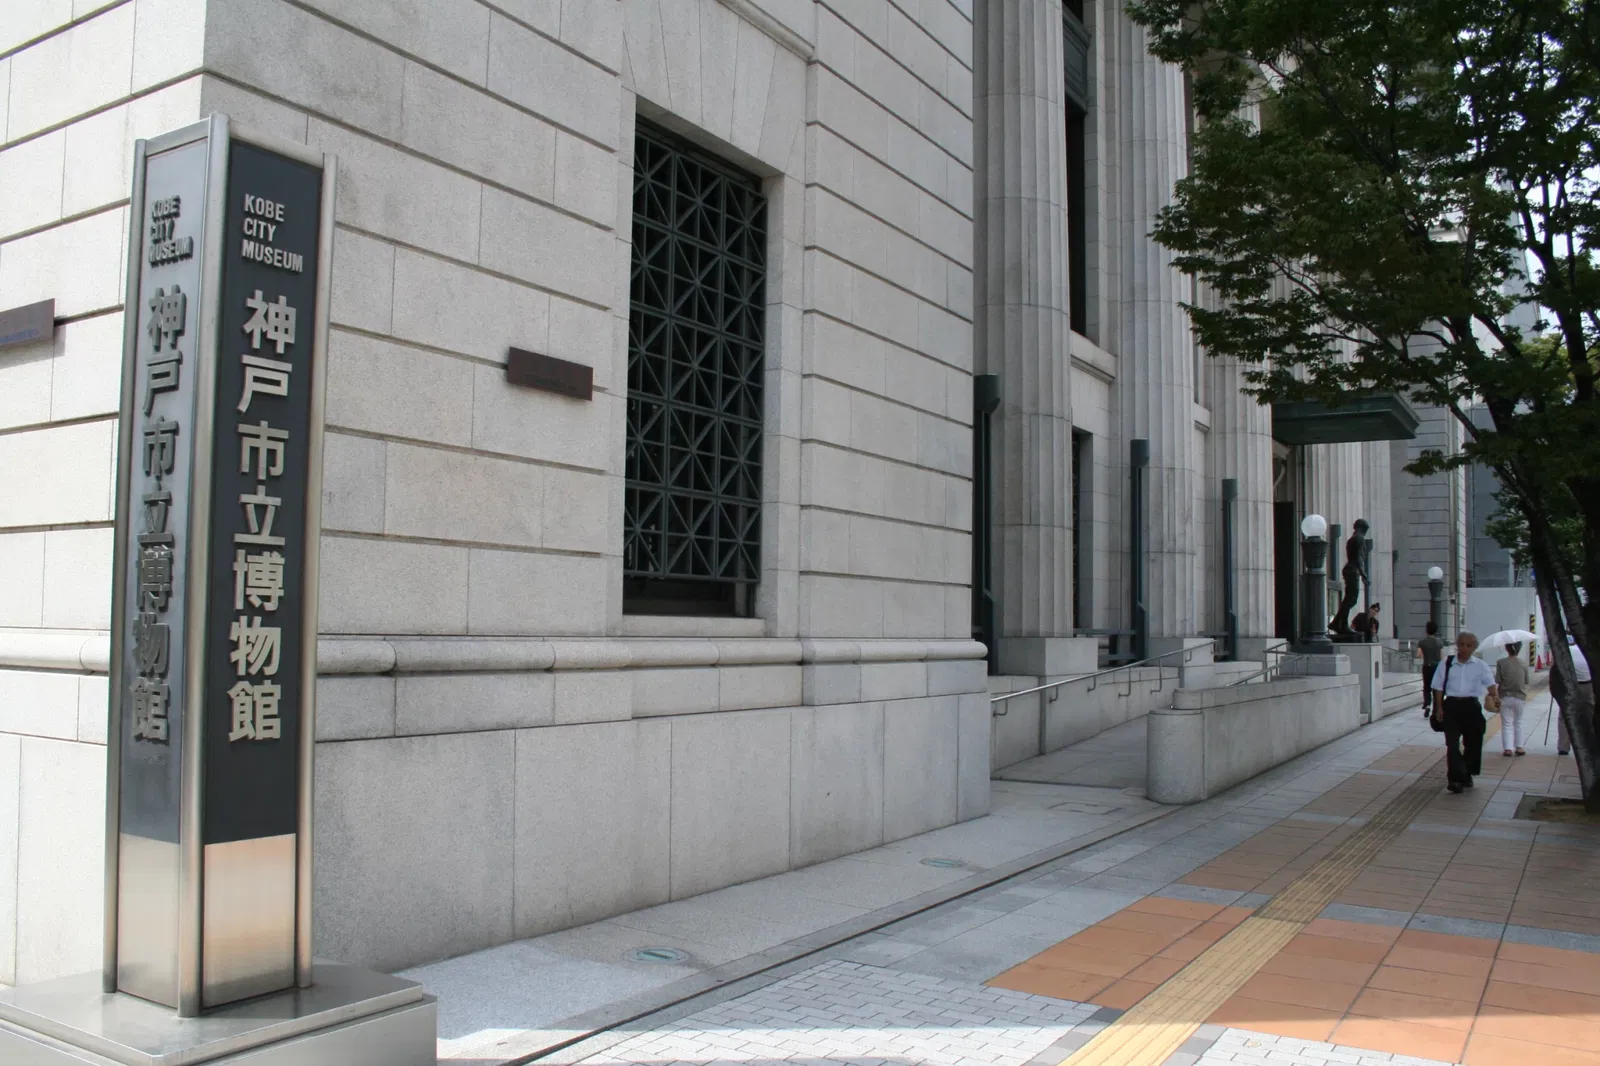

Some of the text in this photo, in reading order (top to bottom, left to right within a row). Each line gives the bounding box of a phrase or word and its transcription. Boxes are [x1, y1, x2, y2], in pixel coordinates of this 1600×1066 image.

[151, 195, 180, 220] KOBE
[244, 194, 285, 222] KOBE
[151, 217, 175, 242] CITY
[243, 219, 276, 242] CITY
[148, 236, 193, 266] MUSEUM
[242, 239, 303, 273] MUSEUM
[130, 284, 187, 744] 神戸市立博物館
[228, 290, 297, 742] 神戸市立博物館
